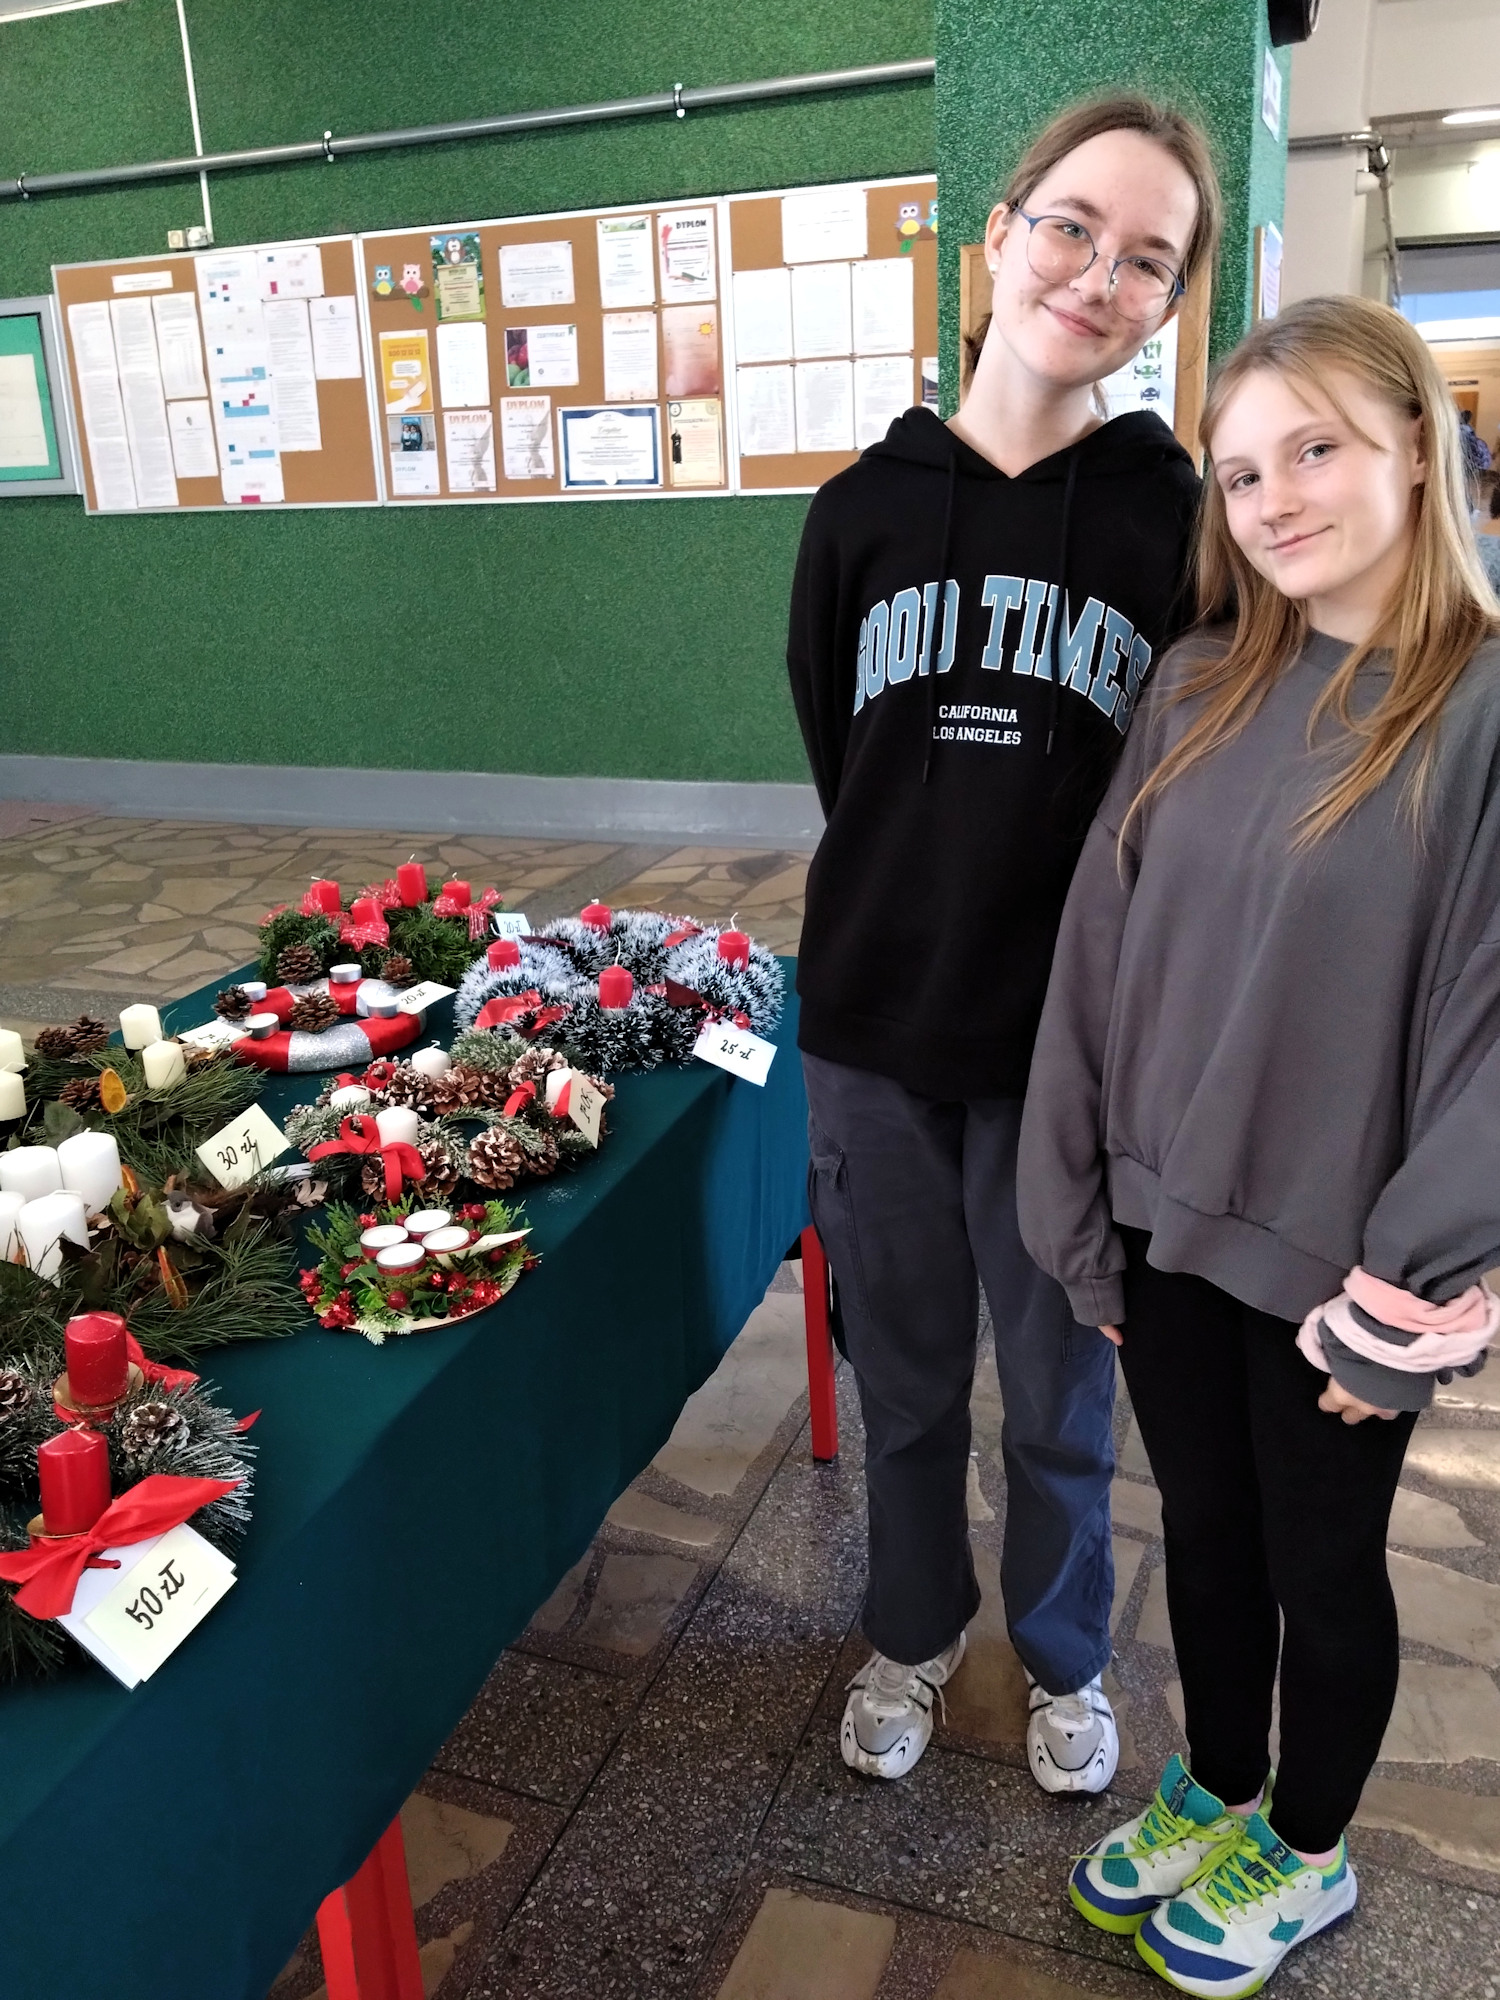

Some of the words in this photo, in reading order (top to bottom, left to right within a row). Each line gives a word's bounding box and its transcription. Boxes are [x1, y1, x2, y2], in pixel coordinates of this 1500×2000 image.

[676, 220, 707, 229] DYPLOM
[981, 575, 1152, 736] TIMES
[939, 705, 1018, 723] CALIFORNIA
[933, 726, 954, 740] LOS
[956, 727, 1022, 745] ANGELES
[720, 1039, 738, 1055] 25
[740, 1048, 756, 1060] zł
[217, 1146, 238, 1170] 30
[240, 1129, 257, 1154] zł
[125, 1586, 163, 1630] 50
